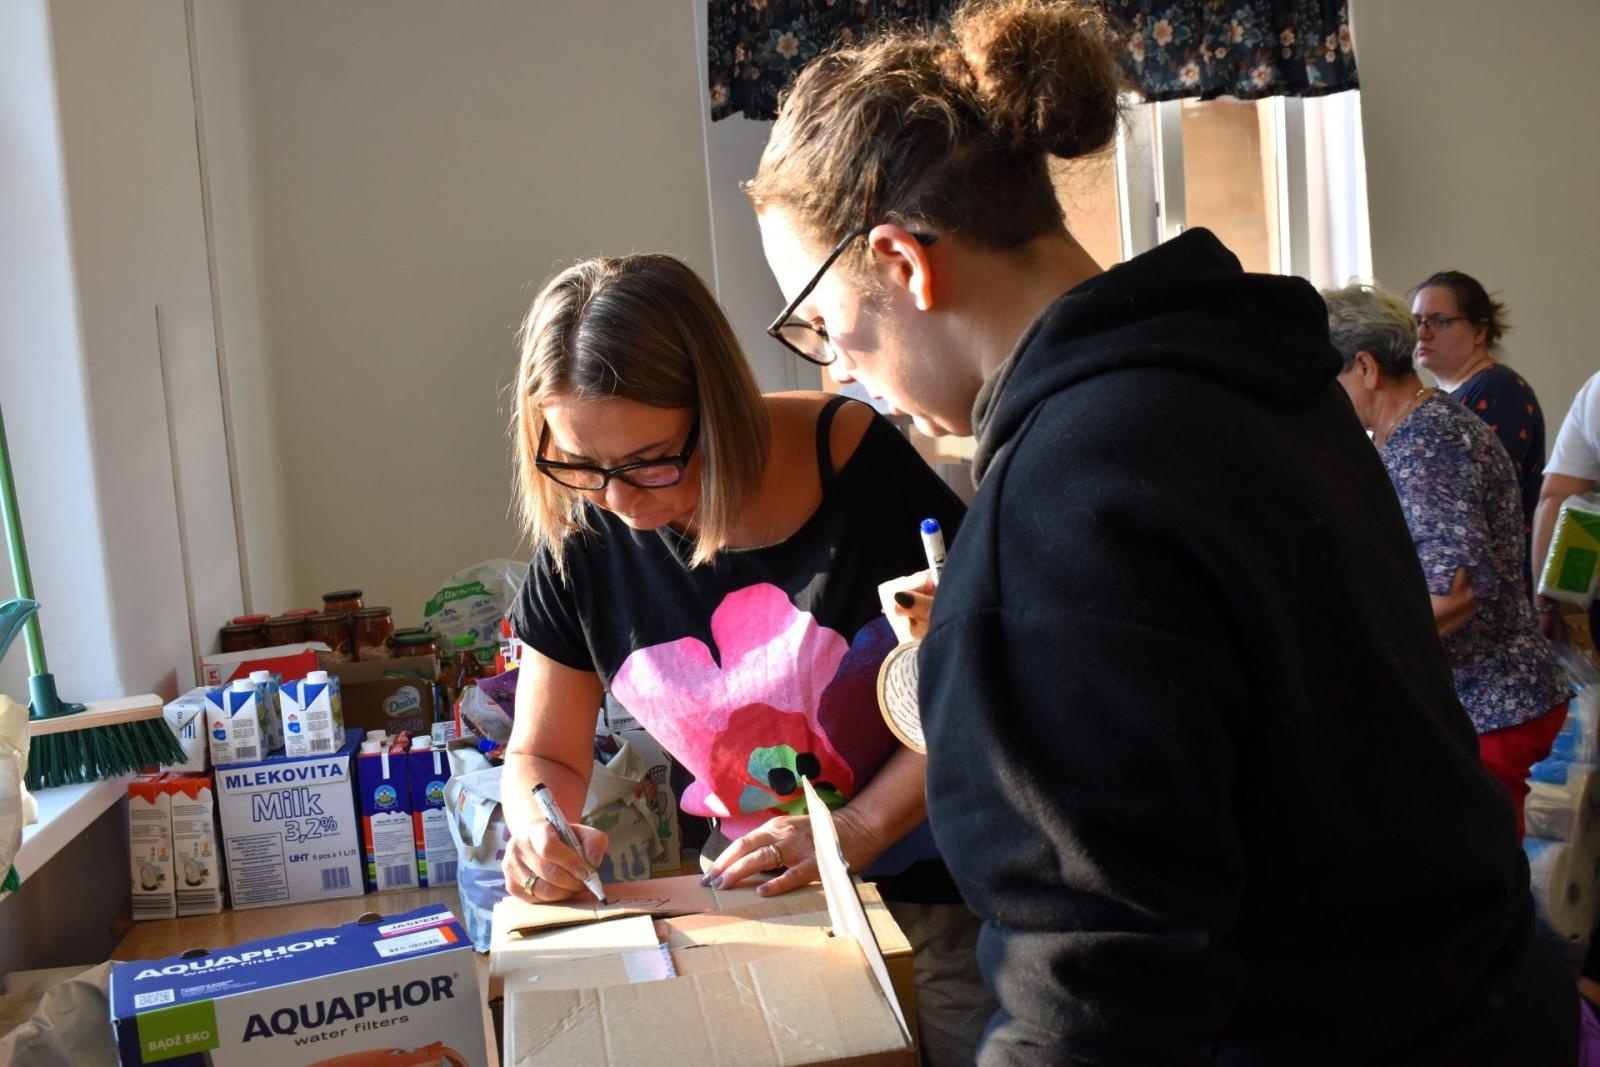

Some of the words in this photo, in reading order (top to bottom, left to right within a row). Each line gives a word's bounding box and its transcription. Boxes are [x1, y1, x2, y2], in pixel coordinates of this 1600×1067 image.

[225, 763, 343, 789] MLEKOVITA
[252, 787, 324, 822] Milk
[284, 816, 338, 844] 3,2%
[289, 853, 310, 863] UHT
[133, 936, 338, 981] AQUAPHOR
[183, 964, 232, 977] water
[241, 954, 294, 967] filters
[242, 975, 455, 1043] AQUAPHOR
[185, 1030, 210, 1043] EKO
[294, 1027, 348, 1046] water
[354, 1014, 409, 1035] filters
